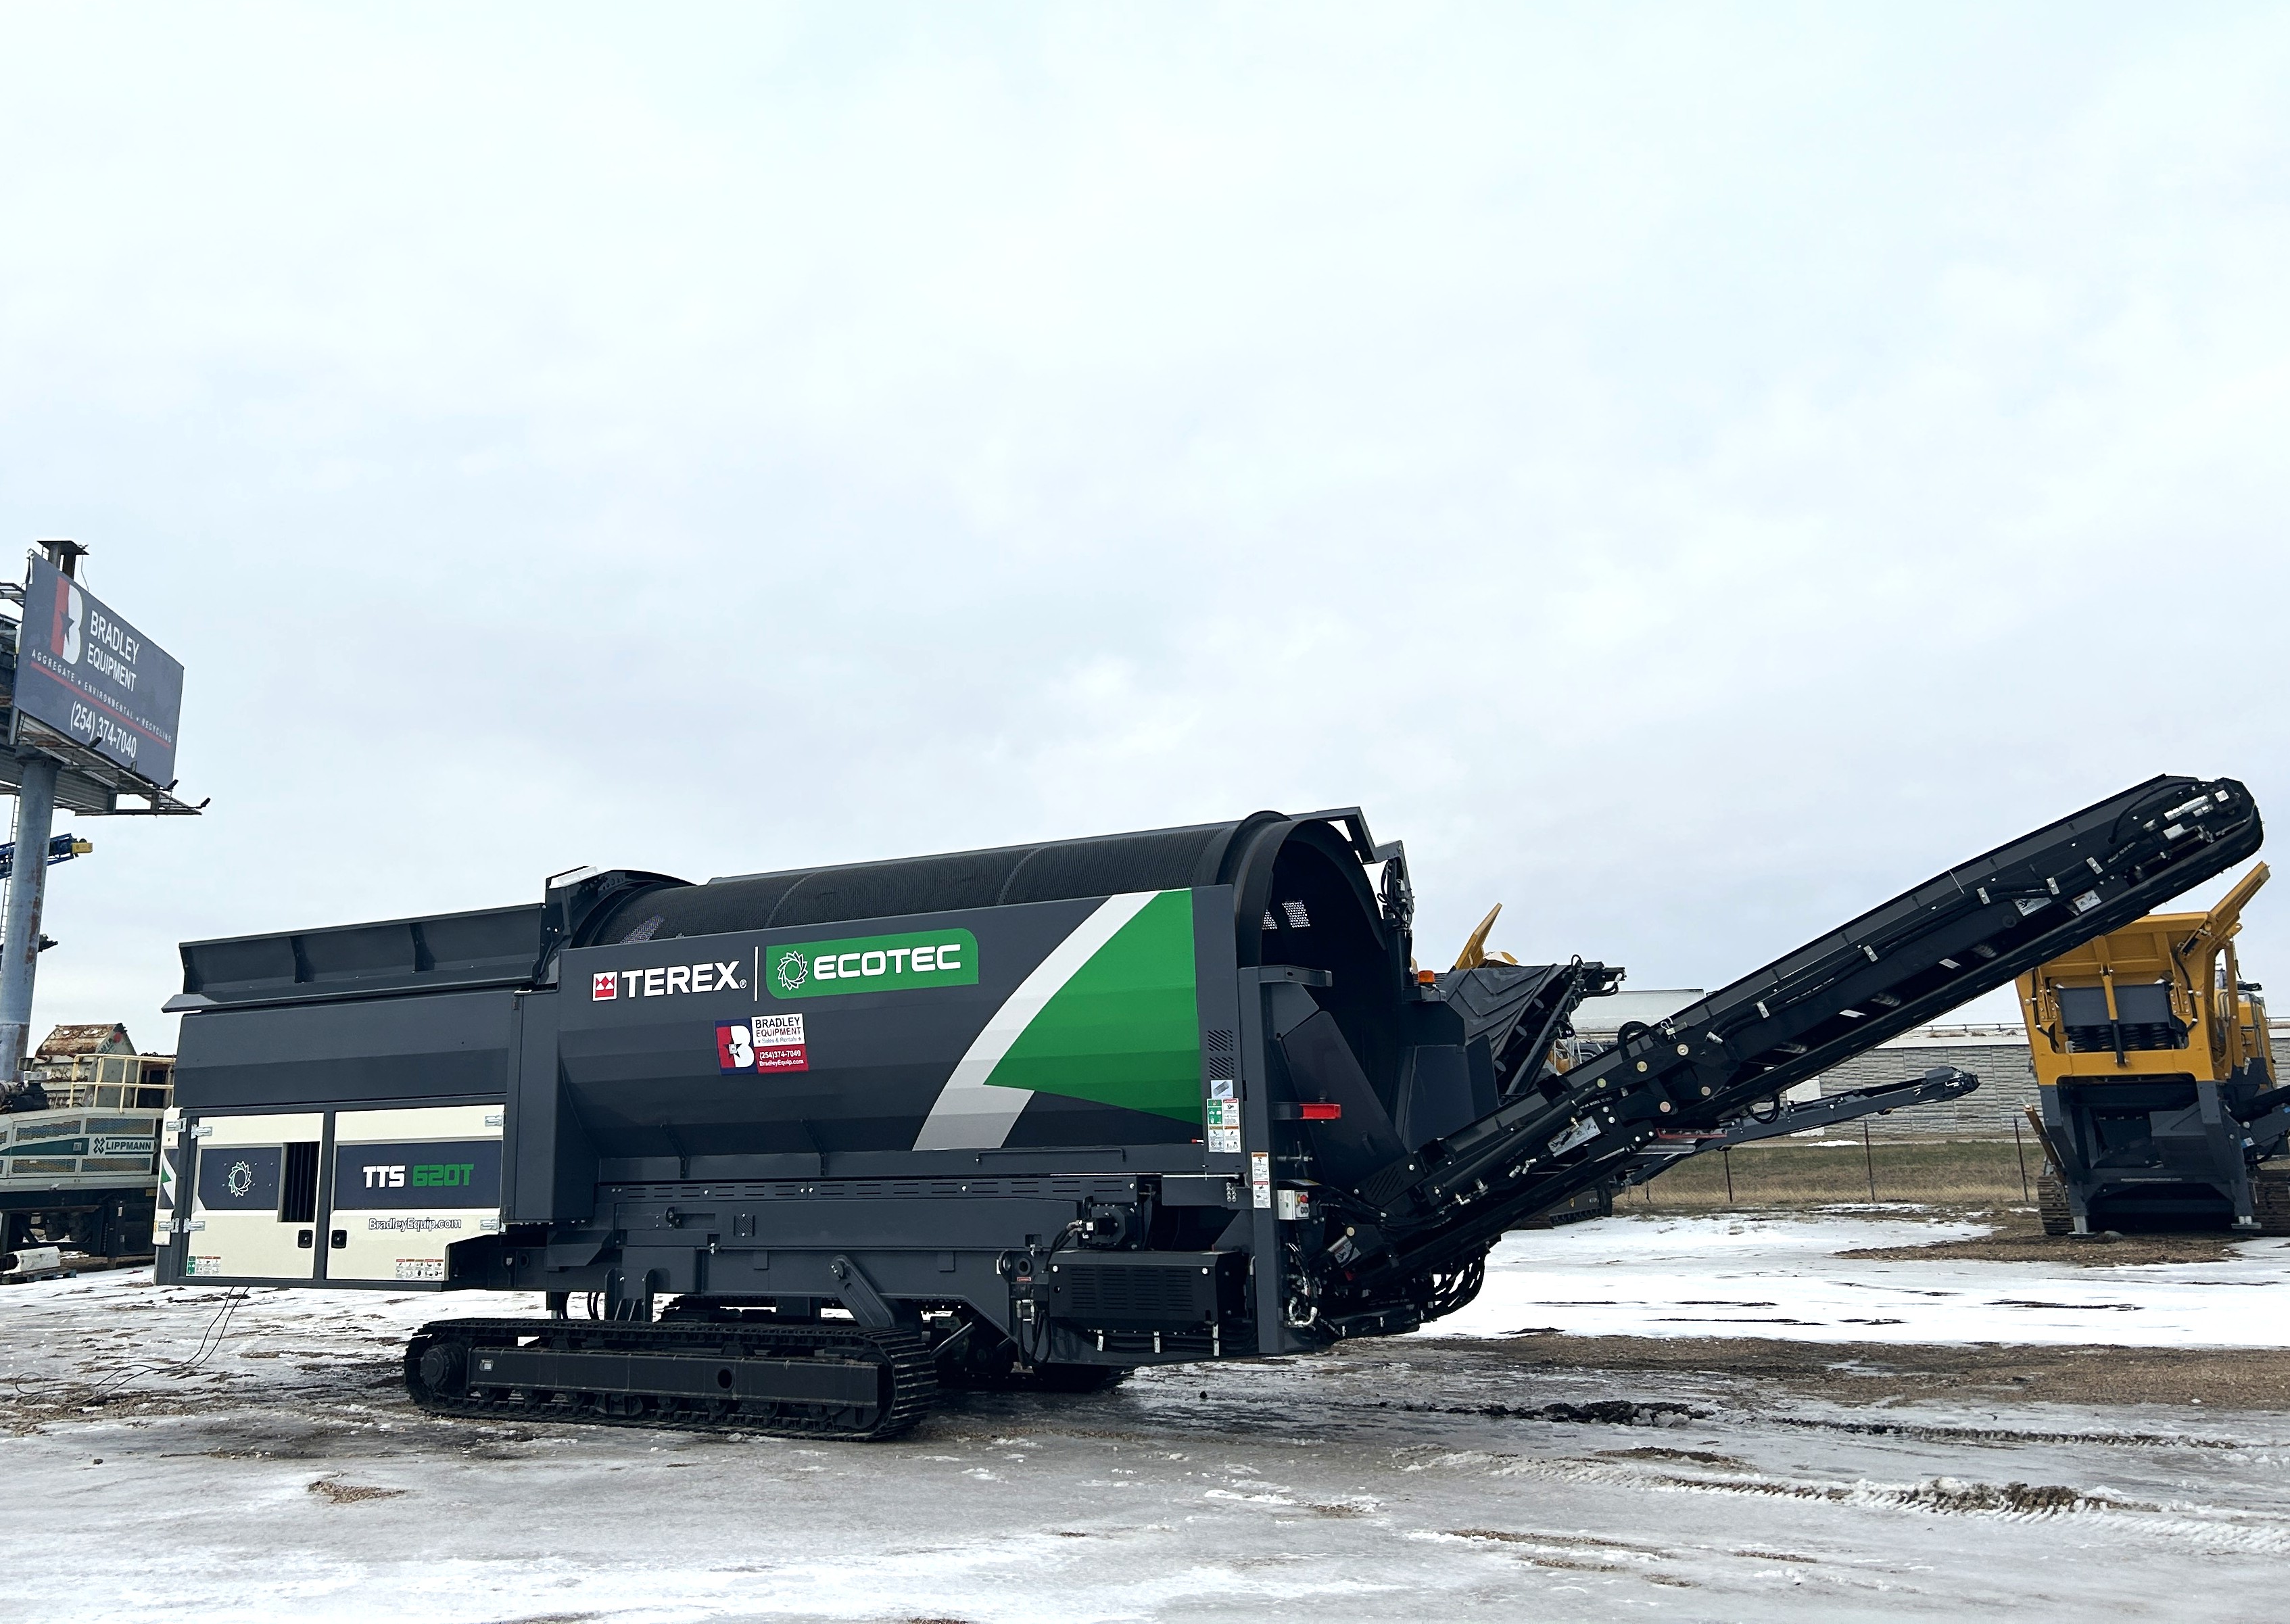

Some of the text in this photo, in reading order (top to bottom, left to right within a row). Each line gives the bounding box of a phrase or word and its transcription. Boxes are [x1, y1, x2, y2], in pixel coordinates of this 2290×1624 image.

[90, 610, 140, 665] BRADLEY
[87, 642, 137, 692] EQUIPMENT
[31, 648, 172, 743] AGGREGATE ENVIRONMENTAL RECYCLING
[70, 700, 137, 759] (254) 374-7040
[813, 944, 961, 981] ECOTEC
[756, 1017, 801, 1028] BRADLEY
[757, 1027, 801, 1036] EQUIPMENT
[760, 1050, 801, 1059] (254)374-7040
[105, 1142, 151, 1151] LIPPMANN
[362, 1163, 475, 1189] TTS 620T
[368, 1217, 462, 1232] BradleyEquip.com
